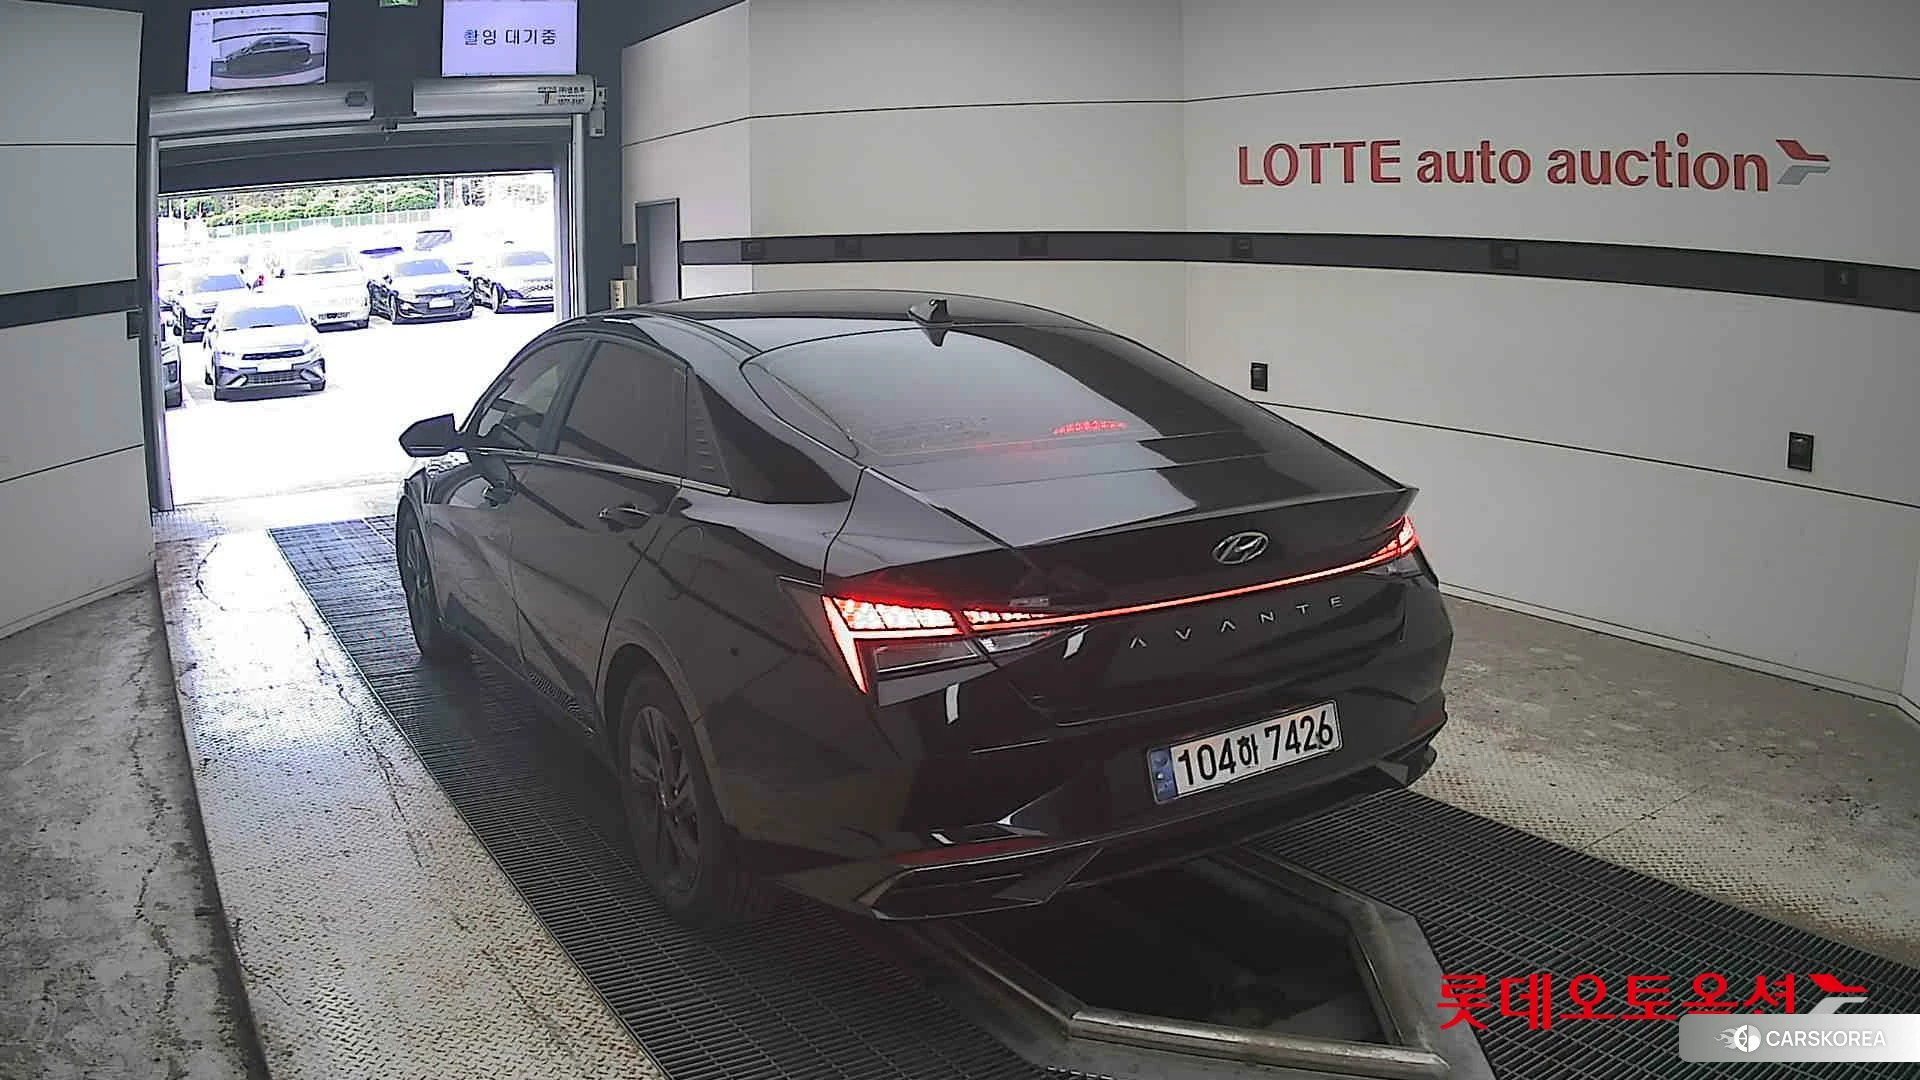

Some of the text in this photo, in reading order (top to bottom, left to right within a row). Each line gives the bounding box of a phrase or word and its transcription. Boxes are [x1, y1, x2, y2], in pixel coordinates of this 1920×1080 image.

[505, 29, 556, 45] 대기중
[1239, 132, 1770, 193] LOTTE auto auction
[1129, 595, 1344, 649] AVANTE
[1177, 710, 1334, 786] 104하 7426
